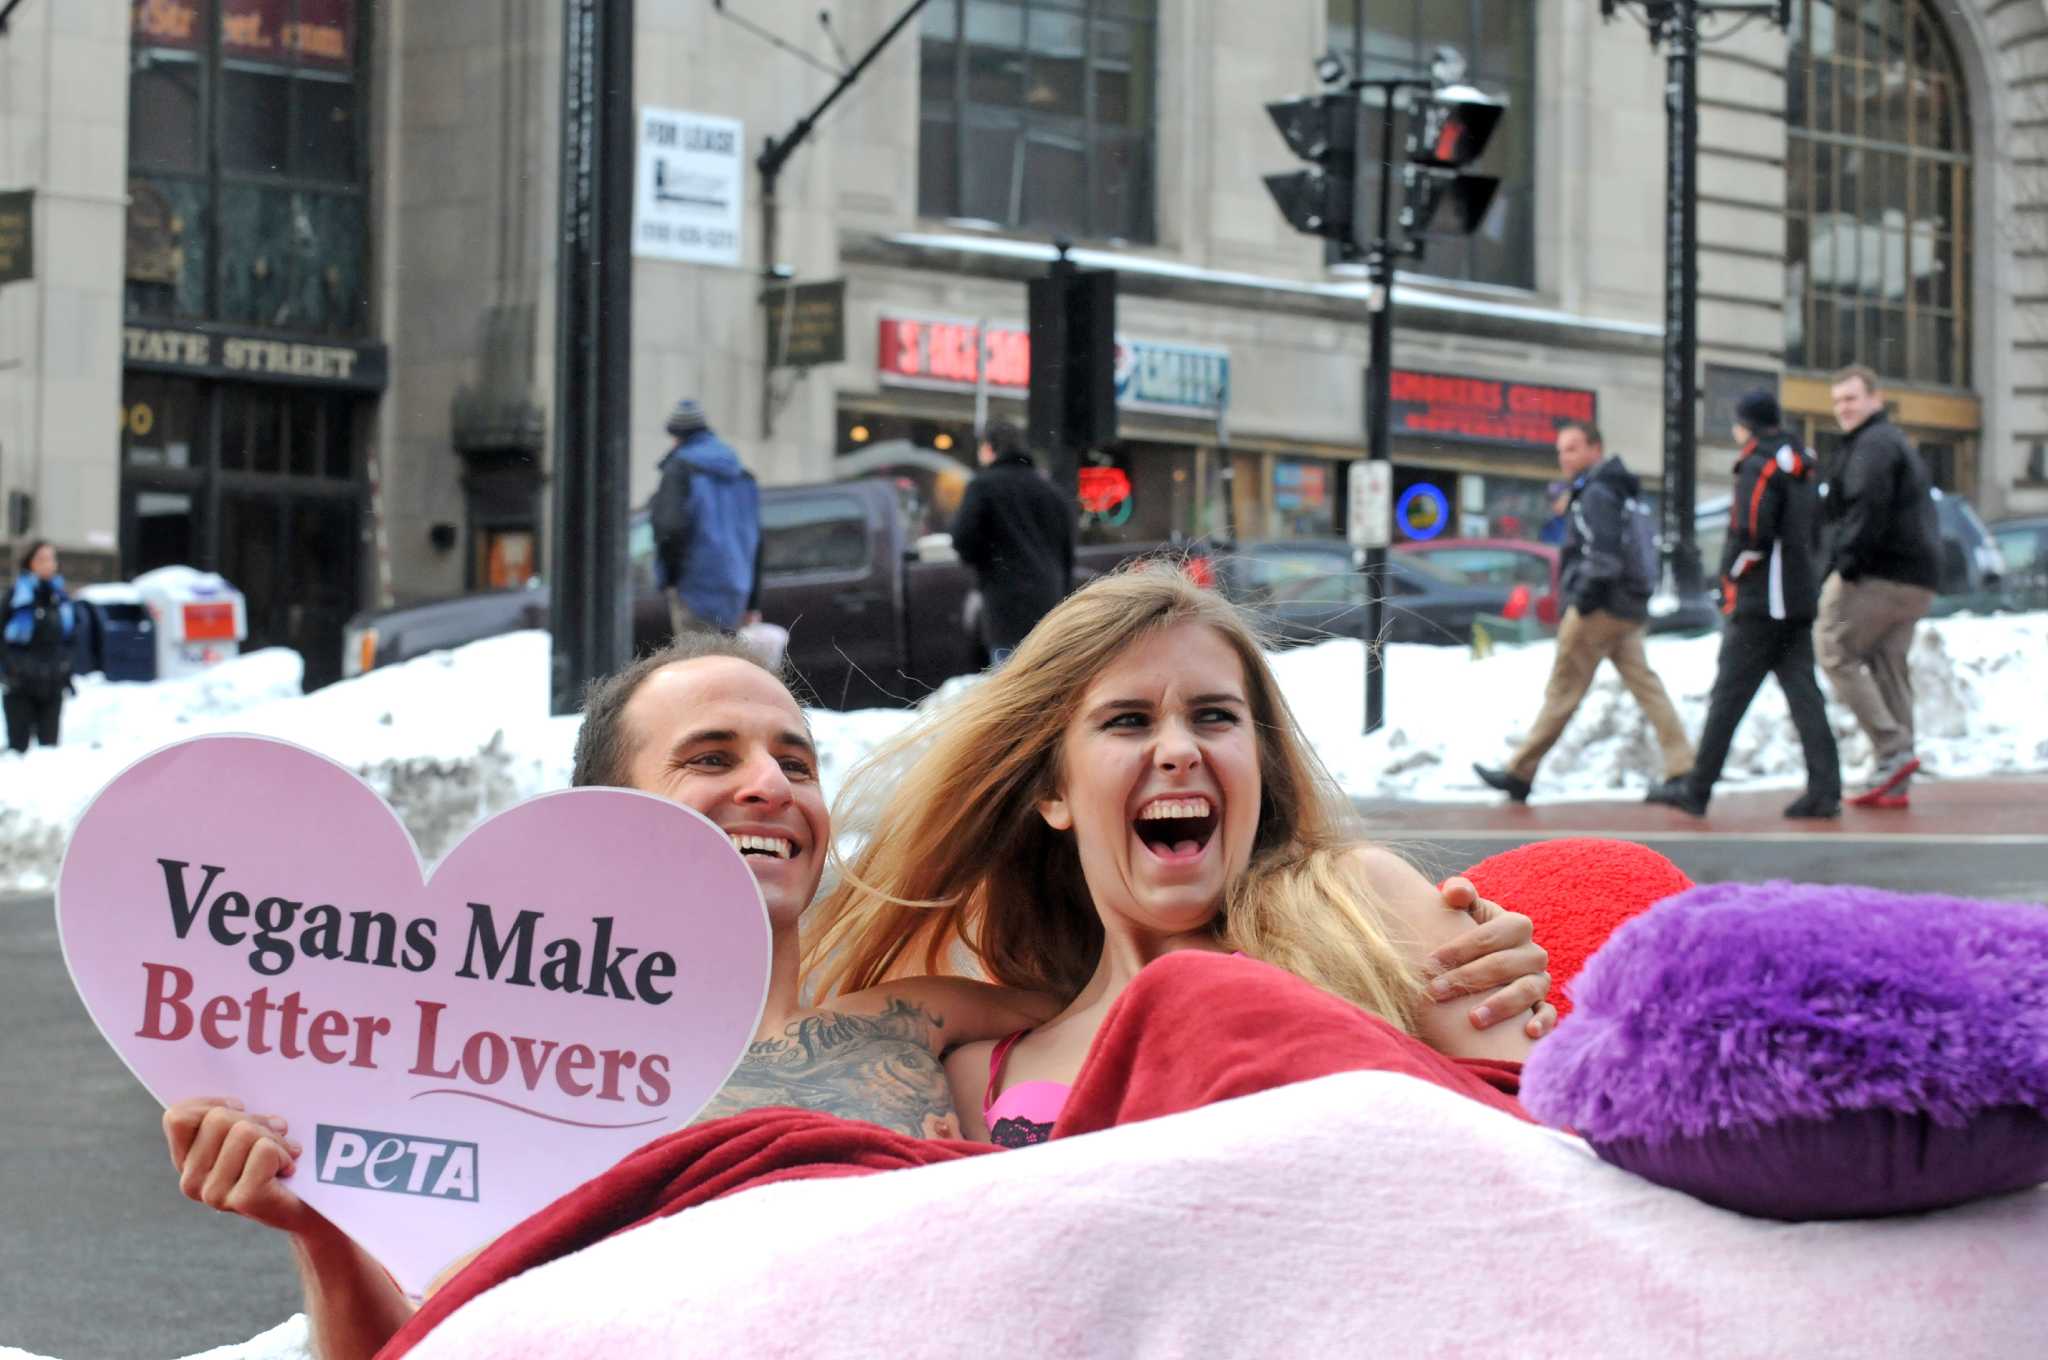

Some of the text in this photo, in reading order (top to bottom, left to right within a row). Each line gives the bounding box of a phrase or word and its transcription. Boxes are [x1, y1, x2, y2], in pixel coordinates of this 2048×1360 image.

[645, 120, 736, 155] FOR LEASE
[124, 328, 357, 380] TATE STREET
[157, 858, 677, 1005] Vegans Make
[134, 961, 392, 1069] Better
[407, 1000, 672, 1107] Lovers
